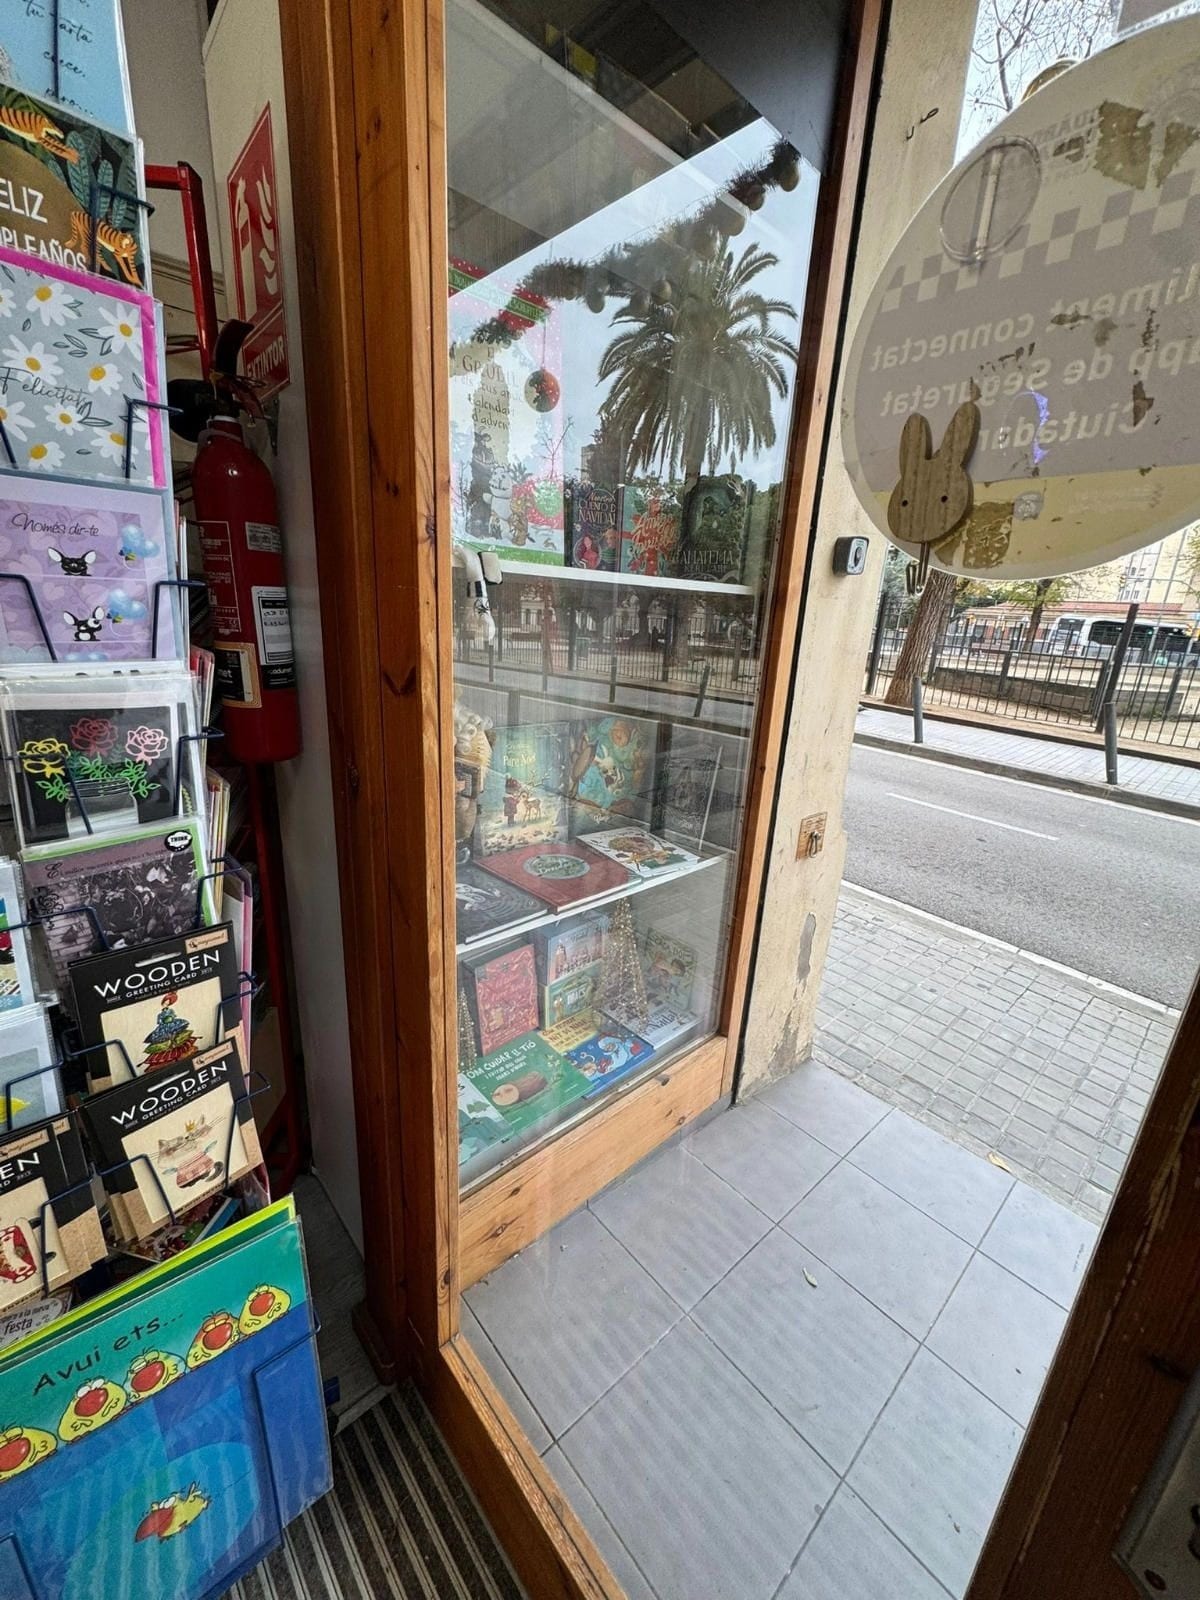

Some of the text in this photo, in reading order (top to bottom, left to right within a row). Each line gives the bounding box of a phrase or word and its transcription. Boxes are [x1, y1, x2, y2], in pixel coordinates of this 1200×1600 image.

[11, 512, 100, 537] Només dir-te
[94, 949, 221, 998] WOODEN
[125, 980, 172, 999] GREETING
[173, 972, 198, 983] CARD
[110, 1060, 228, 1125] WOODEN
[141, 1083, 208, 1120] GREETING CARD
[4, 1318, 33, 1336] festa
[33, 1313, 184, 1397] Avui ets...
